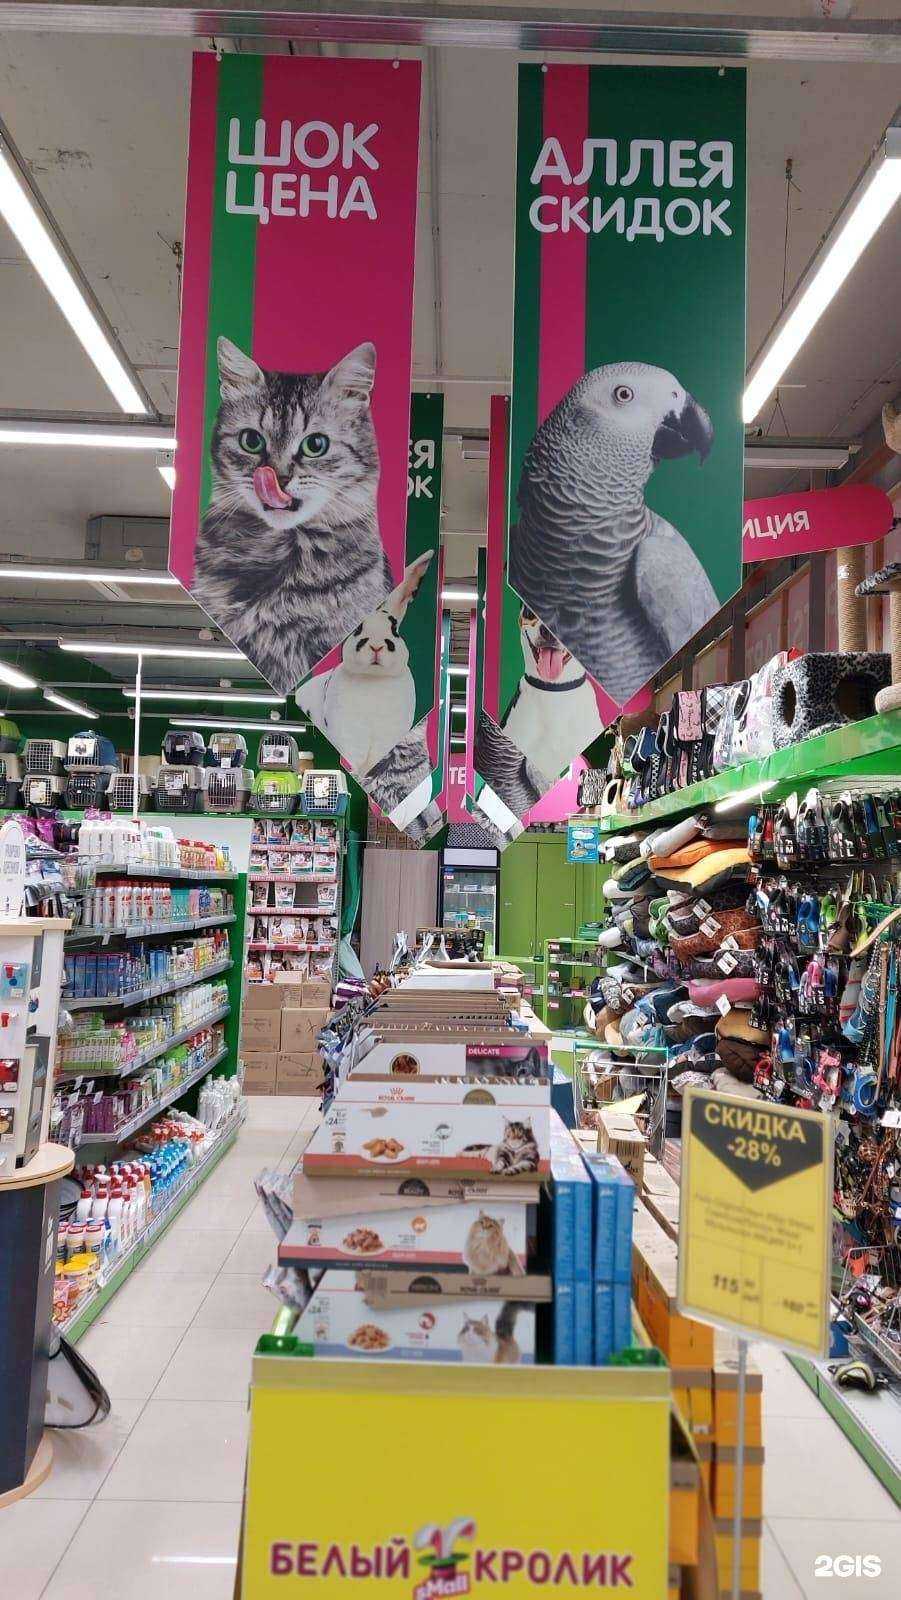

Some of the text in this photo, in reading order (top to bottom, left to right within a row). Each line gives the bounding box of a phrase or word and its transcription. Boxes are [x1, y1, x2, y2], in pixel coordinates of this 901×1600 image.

[228, 117, 380, 170] ШОК
[529, 136, 734, 189] АЛЛЕЯ
[226, 170, 378, 225] ЦЕНА
[529, 195, 733, 243] СКИДОК
[704, 1102, 807, 1144] СКИДКА
[727, 1136, 782, 1167] -28%
[270, 1537, 634, 1587] БЕЛЫЙ КРОЛИК
